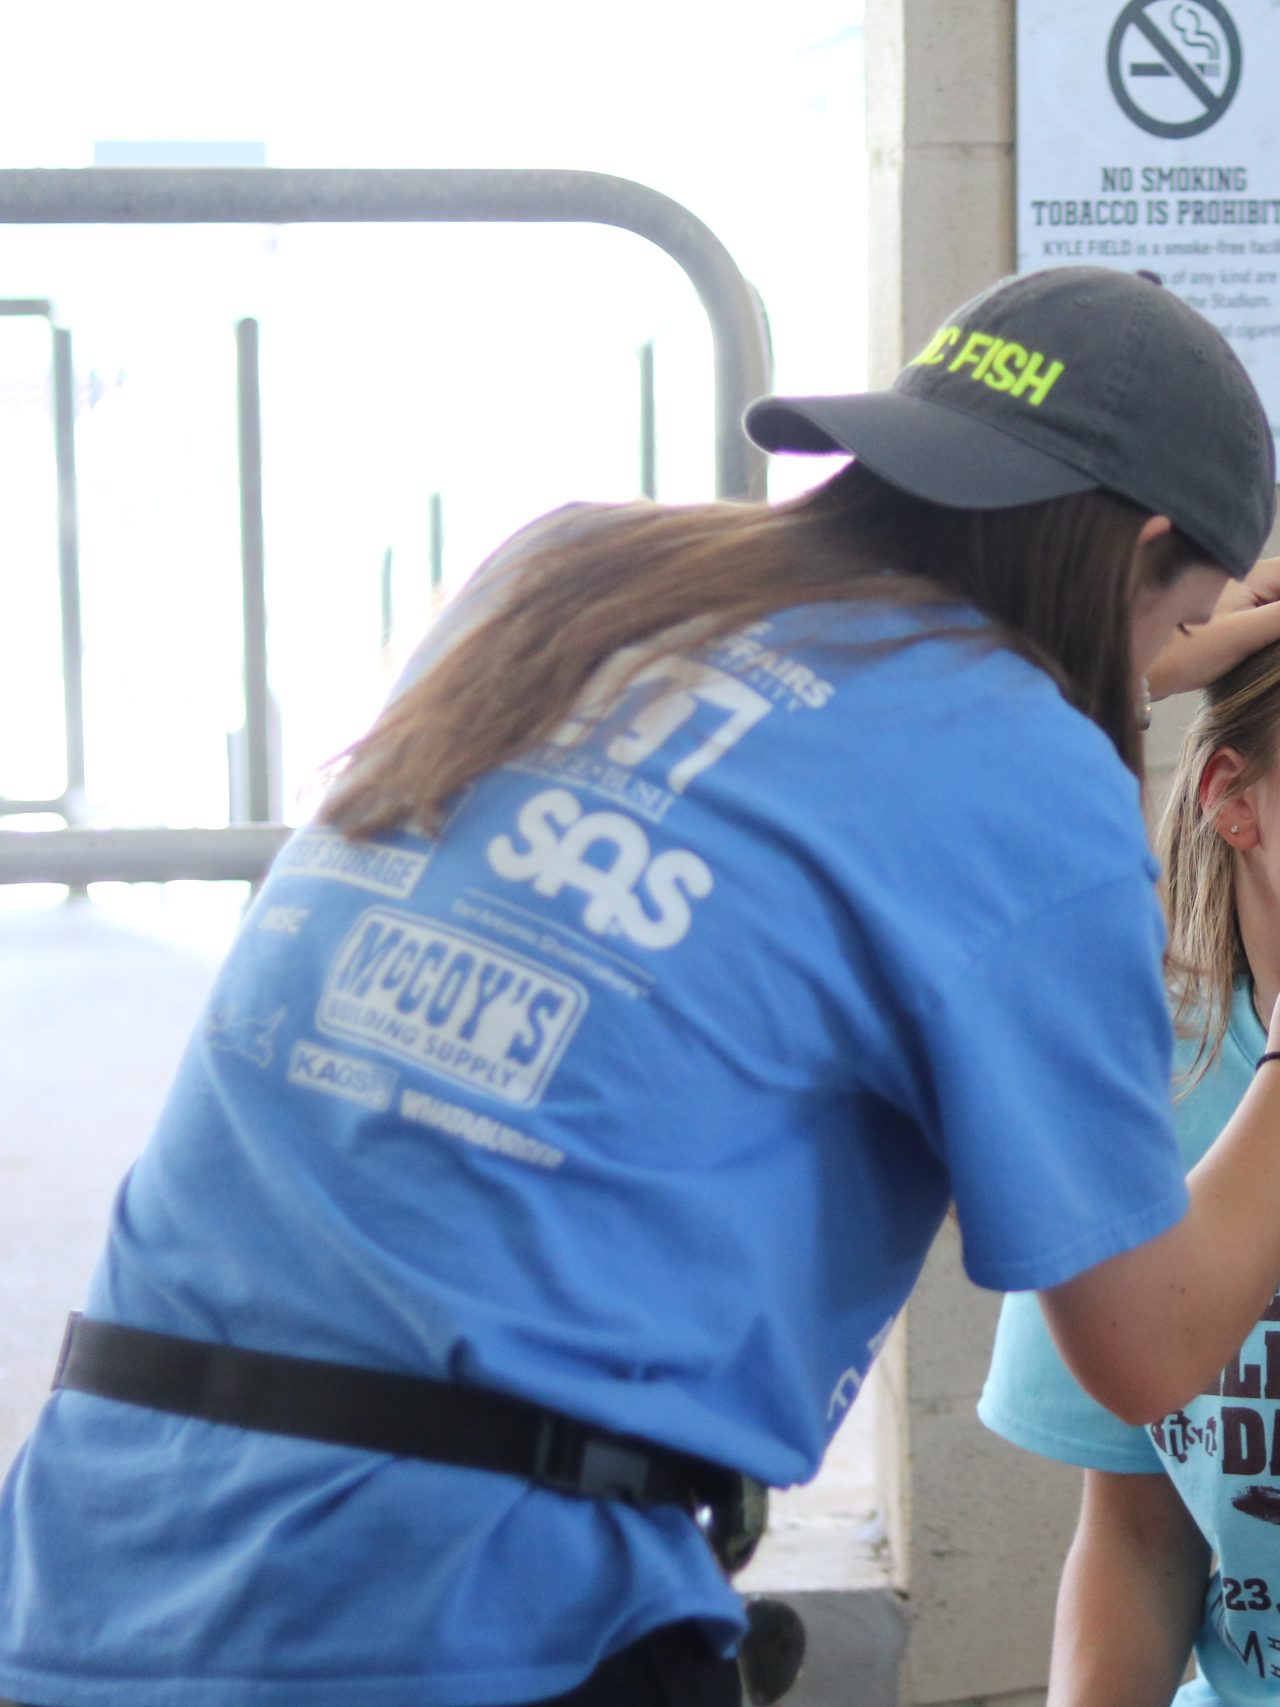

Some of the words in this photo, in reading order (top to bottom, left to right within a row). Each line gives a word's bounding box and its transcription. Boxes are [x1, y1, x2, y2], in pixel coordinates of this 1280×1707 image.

[1102, 166, 1133, 193] NO
[1141, 166, 1247, 193] SMOKING
[1031, 200, 1138, 226] TOBACCO
[1146, 200, 1168, 226] IS
[1043, 240, 1082, 256] KYLE
[1088, 240, 1132, 256] FIELD
[948, 331, 1065, 407] FISH
[327, 996, 419, 1045] BUILDING
[424, 1034, 519, 1088] SUPPLY
